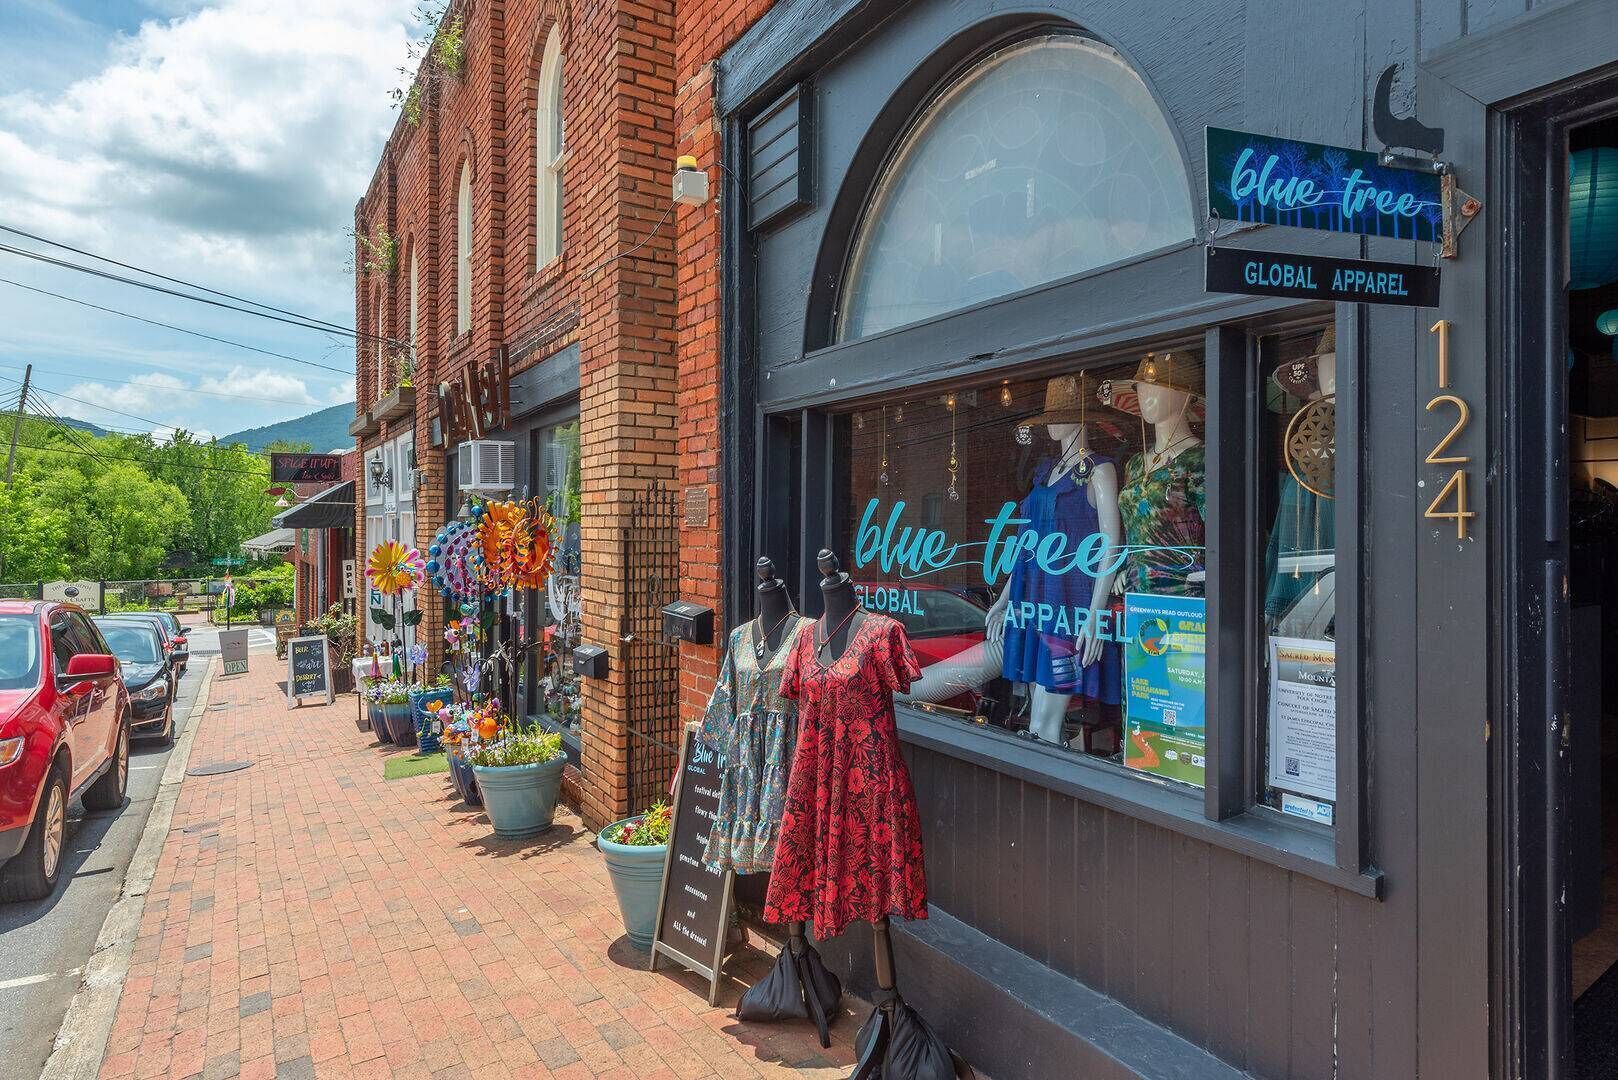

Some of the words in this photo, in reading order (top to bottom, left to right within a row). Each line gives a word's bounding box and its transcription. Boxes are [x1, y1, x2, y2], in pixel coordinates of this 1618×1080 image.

[1231, 148, 1323, 210] blue
[1342, 168, 1424, 219] tree
[1244, 261, 1318, 290] GLOBAL
[1331, 268, 1409, 297] APPAREL
[1424, 320, 1475, 539] 124
[855, 497, 958, 579] blue
[980, 501, 1132, 586] tree
[345, 564, 354, 594] OPEN
[853, 584, 926, 617] GLOBAL
[1003, 600, 1135, 645] APPAREL
[1161, 609, 1177, 617] READ
[1177, 611, 1203, 619] OUTLOUD
[225, 660, 247, 673] OPEN
[693, 741, 714, 764] Blue
[687, 765, 707, 776] GLOBAL
[694, 784, 712, 797] festival
[695, 804, 708, 818] flowy
[679, 853, 699, 868] gemstone
[686, 909, 696, 920] and
[672, 920, 682, 931] ALL
